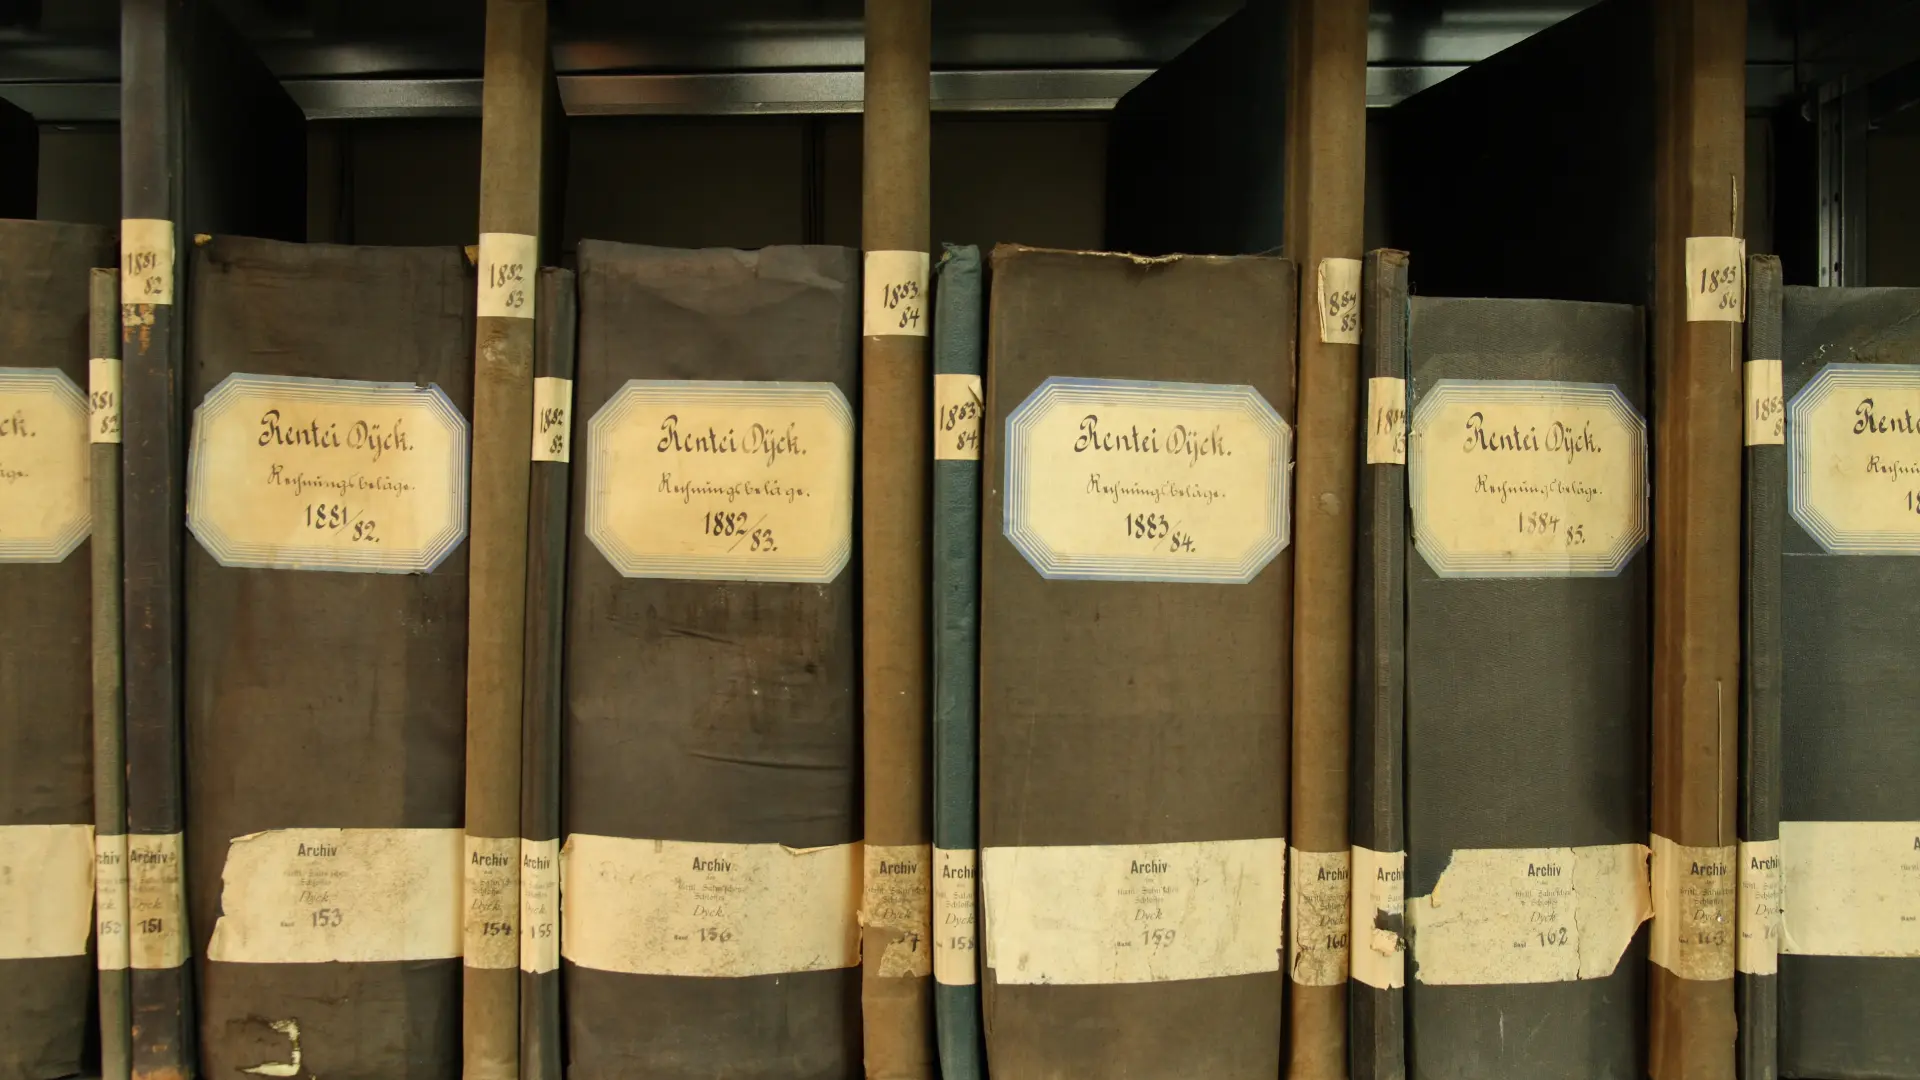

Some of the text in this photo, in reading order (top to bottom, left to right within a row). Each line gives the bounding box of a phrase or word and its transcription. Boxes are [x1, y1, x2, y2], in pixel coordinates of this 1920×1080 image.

[127, 251, 157, 276] 1881
[490, 263, 525, 288] 1882
[1700, 266, 1737, 294] 1885
[143, 276, 162, 294] 82
[506, 290, 525, 308] 83
[883, 281, 919, 309] 1883
[1718, 291, 1737, 310] 86
[899, 306, 920, 329] 84
[90, 391, 113, 415] 881
[540, 408, 564, 433] 1882
[1853, 398, 1920, 435] Rente
[258, 409, 341, 449] Rentei
[657, 414, 738, 453] Rentei
[1074, 414, 1160, 453] Rentei
[1463, 411, 1540, 453] Rentei
[1773, 418, 1785, 436] 8
[95, 851, 121, 865] chiv
[130, 850, 168, 865] Archiv
[297, 843, 338, 857] Archiv
[471, 851, 509, 867] Archiv
[523, 854, 551, 870] Archiv
[692, 856, 732, 872] Archiv
[879, 860, 918, 875] Archiv
[1130, 860, 1168, 875] Archiv
[1751, 854, 1779, 870] Archi
[942, 864, 975, 879] Archi
[1377, 867, 1404, 882] Arch
[1527, 863, 1562, 877] Archiv
[1690, 862, 1727, 876] Archiv
[137, 918, 163, 934] 151
[311, 908, 343, 928] 153
[482, 922, 512, 936] 154
[531, 923, 553, 939] 155
[697, 927, 733, 943] 156
[1537, 926, 1569, 948] 162
[1764, 924, 1778, 940] 16
[1141, 928, 1176, 949] 159
[1326, 934, 1347, 950] 160
